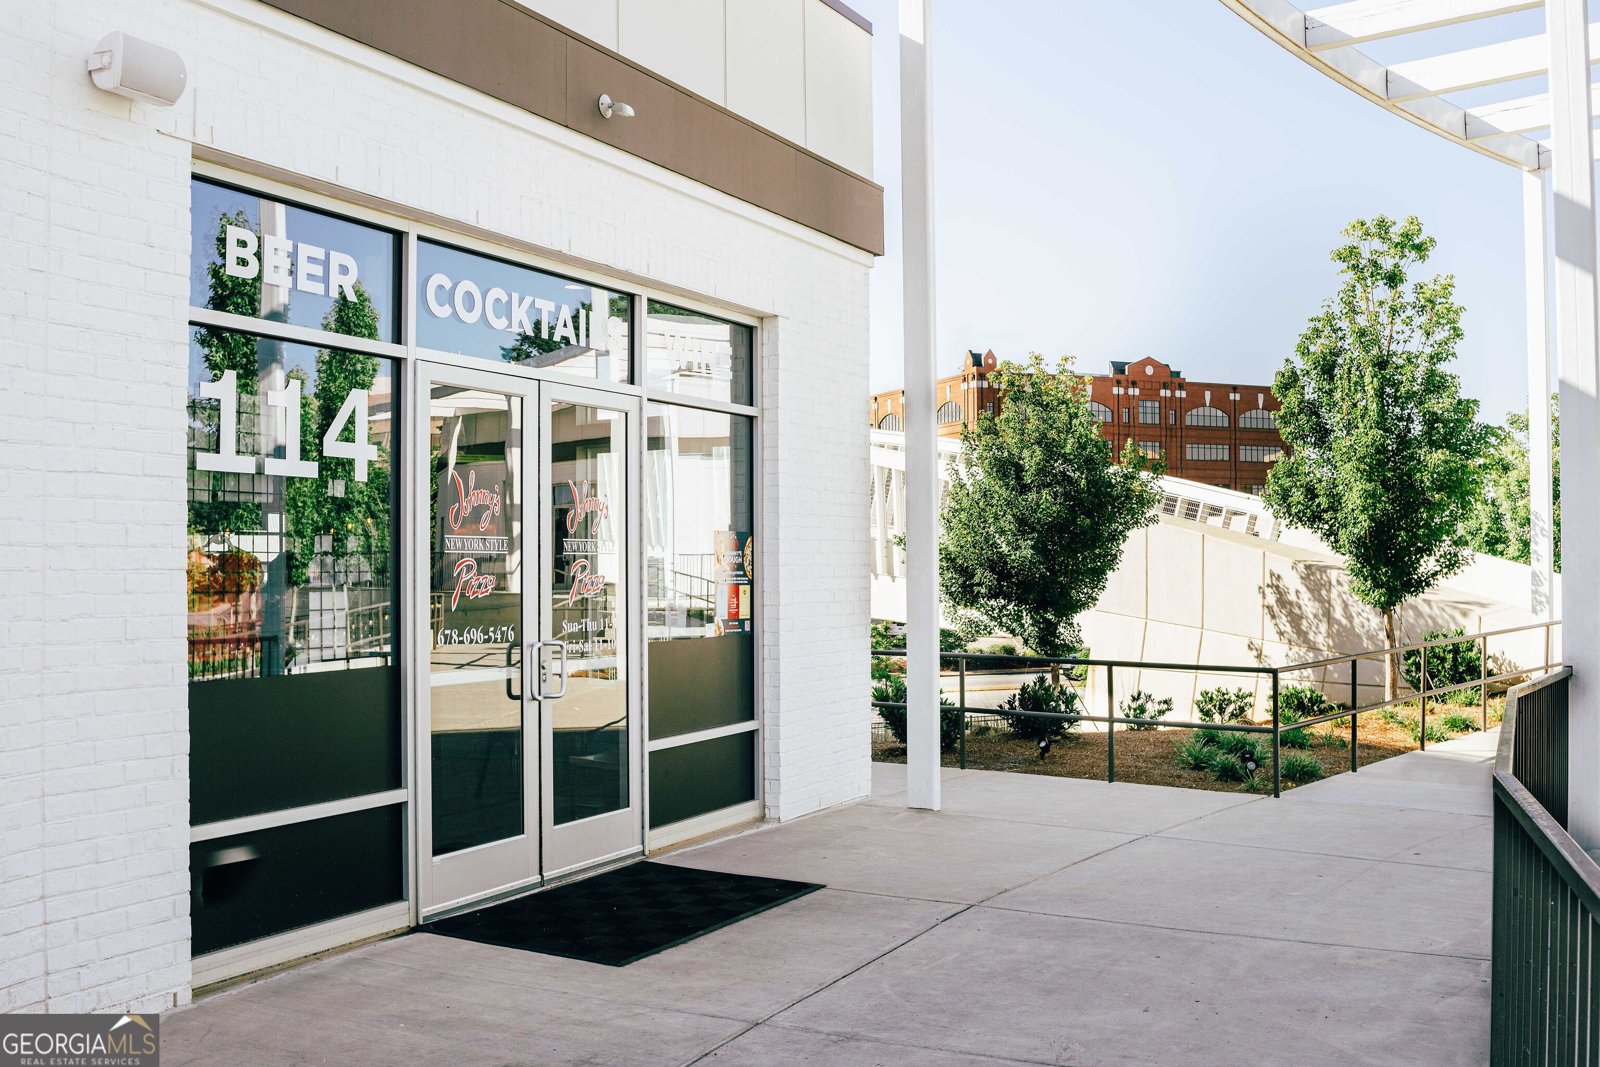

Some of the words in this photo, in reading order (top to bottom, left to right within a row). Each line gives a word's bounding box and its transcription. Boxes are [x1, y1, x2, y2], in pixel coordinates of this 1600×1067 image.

[225, 224, 359, 303] BEER
[196, 369, 378, 482] 114
[449, 470, 501, 531] Johnny's
[566, 479, 609, 535] Johnny's
[445, 537, 462, 550] NEW
[463, 538, 484, 550] YORK
[486, 538, 509, 551] STYLE
[563, 541, 578, 552] NEW
[578, 541, 597, 552] YORK
[452, 558, 497, 612] Pizza
[568, 559, 606, 608] Pizza
[437, 623, 515, 647] 678-696-5476
[562, 618, 597, 633] Sun-Thu
